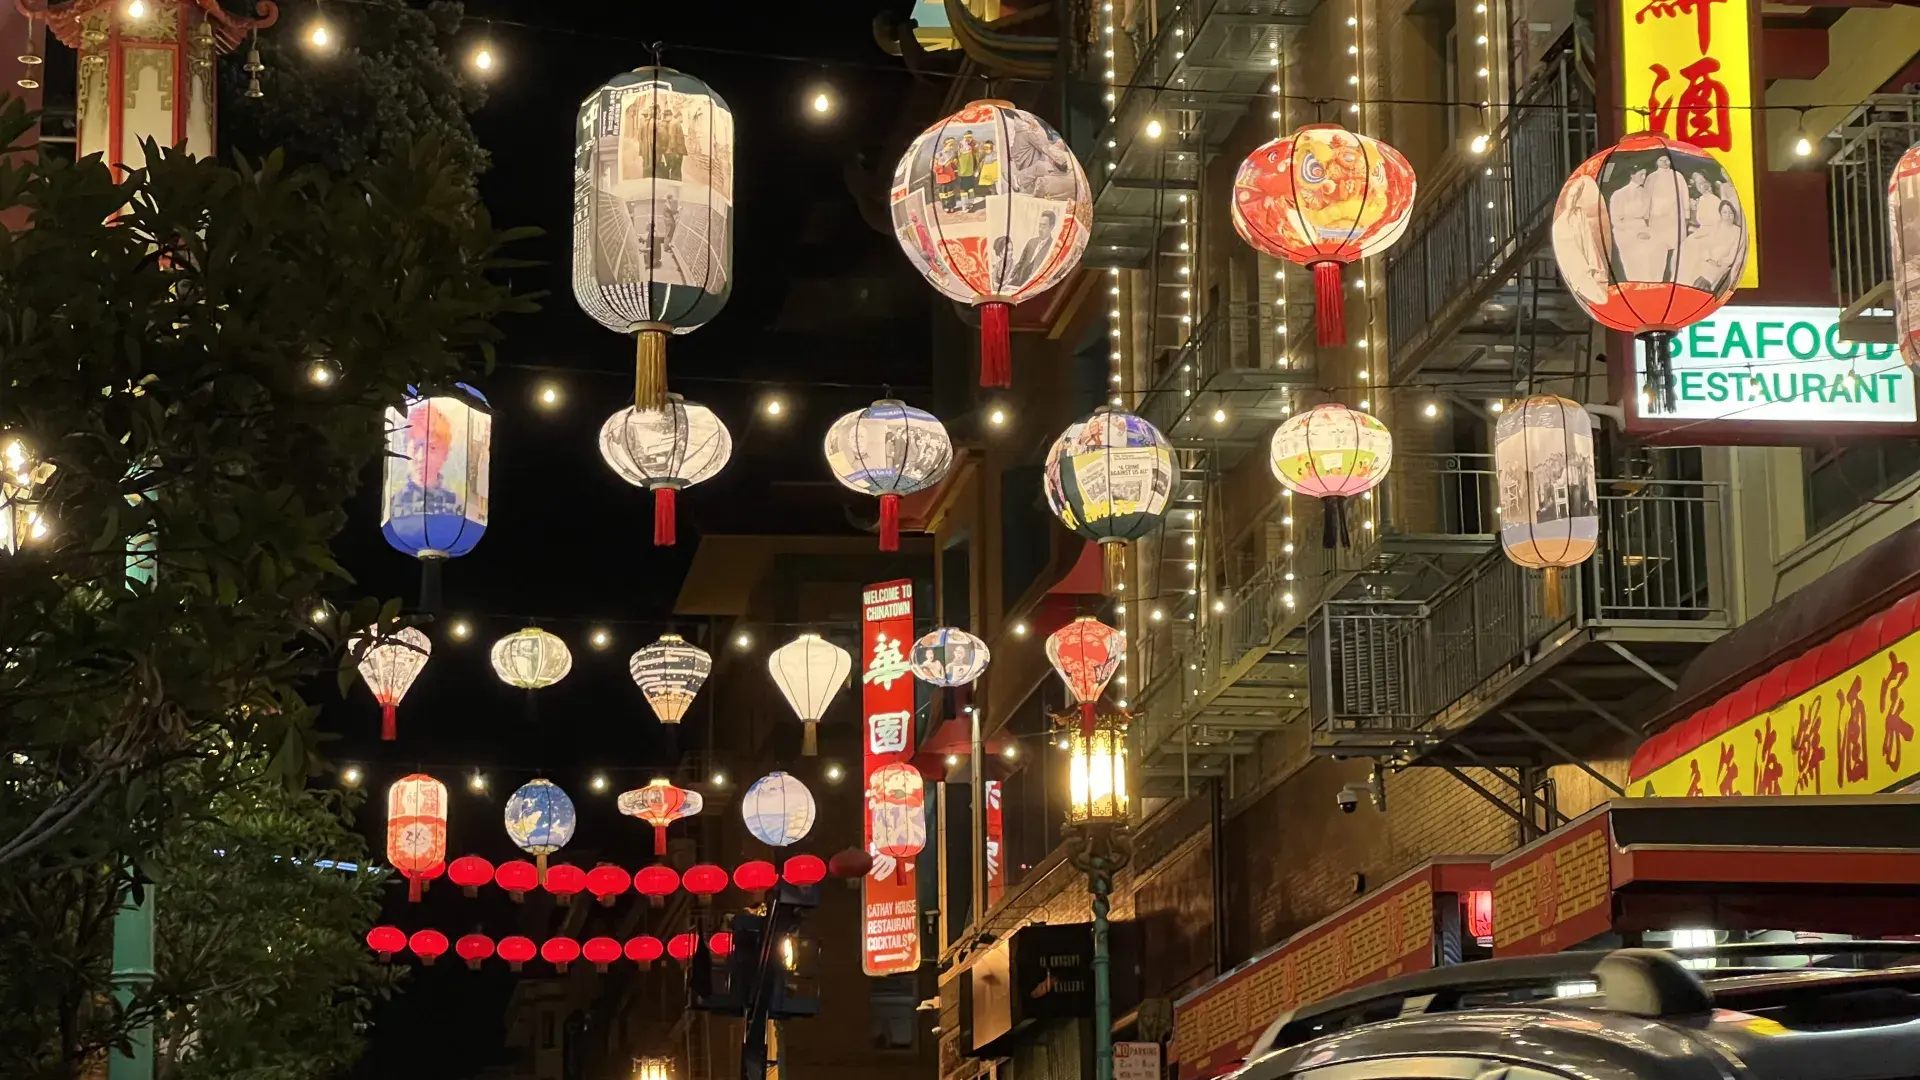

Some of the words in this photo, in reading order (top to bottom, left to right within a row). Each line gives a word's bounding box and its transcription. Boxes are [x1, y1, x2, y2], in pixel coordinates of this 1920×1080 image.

[1635, 0, 1733, 153] 酒
[1671, 371, 1902, 404] ESTAURANT
[863, 586, 899, 605] WELCOME
[901, 584, 912, 598] TO
[866, 601, 910, 621] CHINATOWN
[867, 901, 893, 918] CATHAY
[895, 899, 916, 915] HOUSE
[867, 916, 916, 934] RESTAURANT
[867, 933, 908, 951] COCKTAILS
[1116, 1044, 1129, 1057] NO
[1130, 1047, 1157, 1056] PARKING
